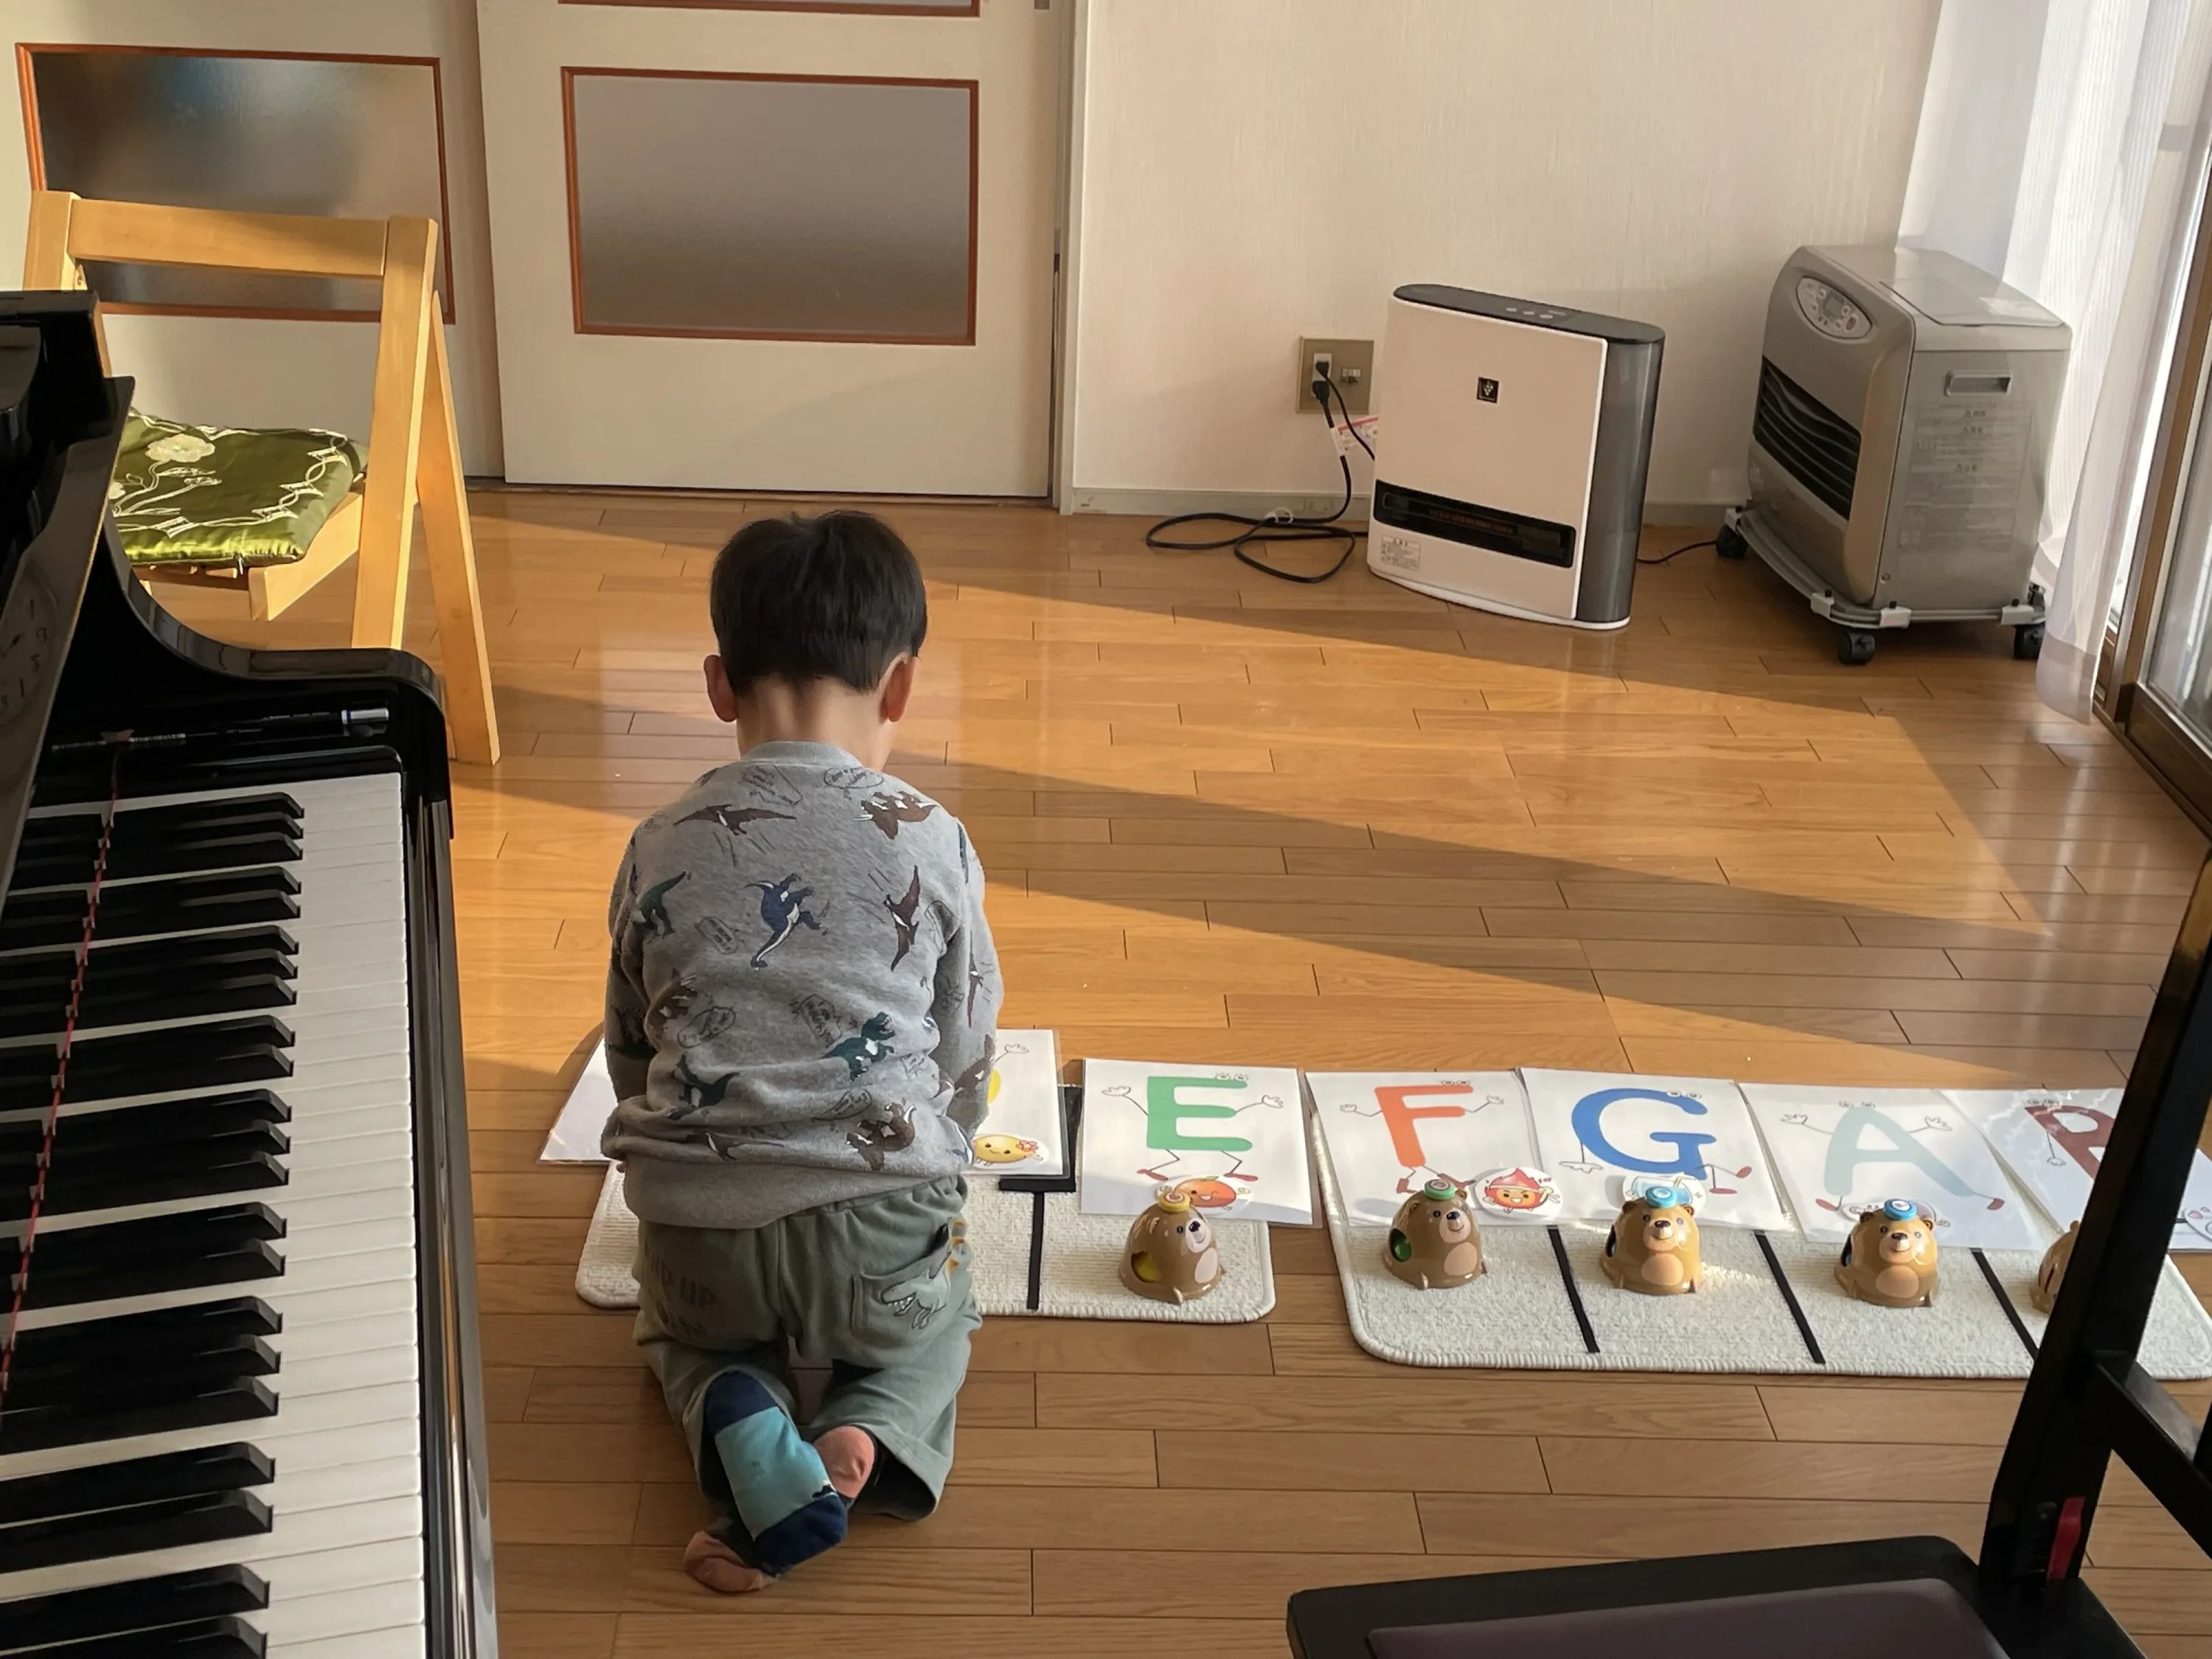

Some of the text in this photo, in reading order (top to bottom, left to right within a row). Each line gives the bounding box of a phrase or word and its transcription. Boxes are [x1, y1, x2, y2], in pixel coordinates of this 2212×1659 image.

[1147, 1077, 1253, 1151] E
[1374, 1085, 1474, 1168] F
[1572, 1088, 1717, 1180] G
[1825, 1105, 1974, 1198] A
